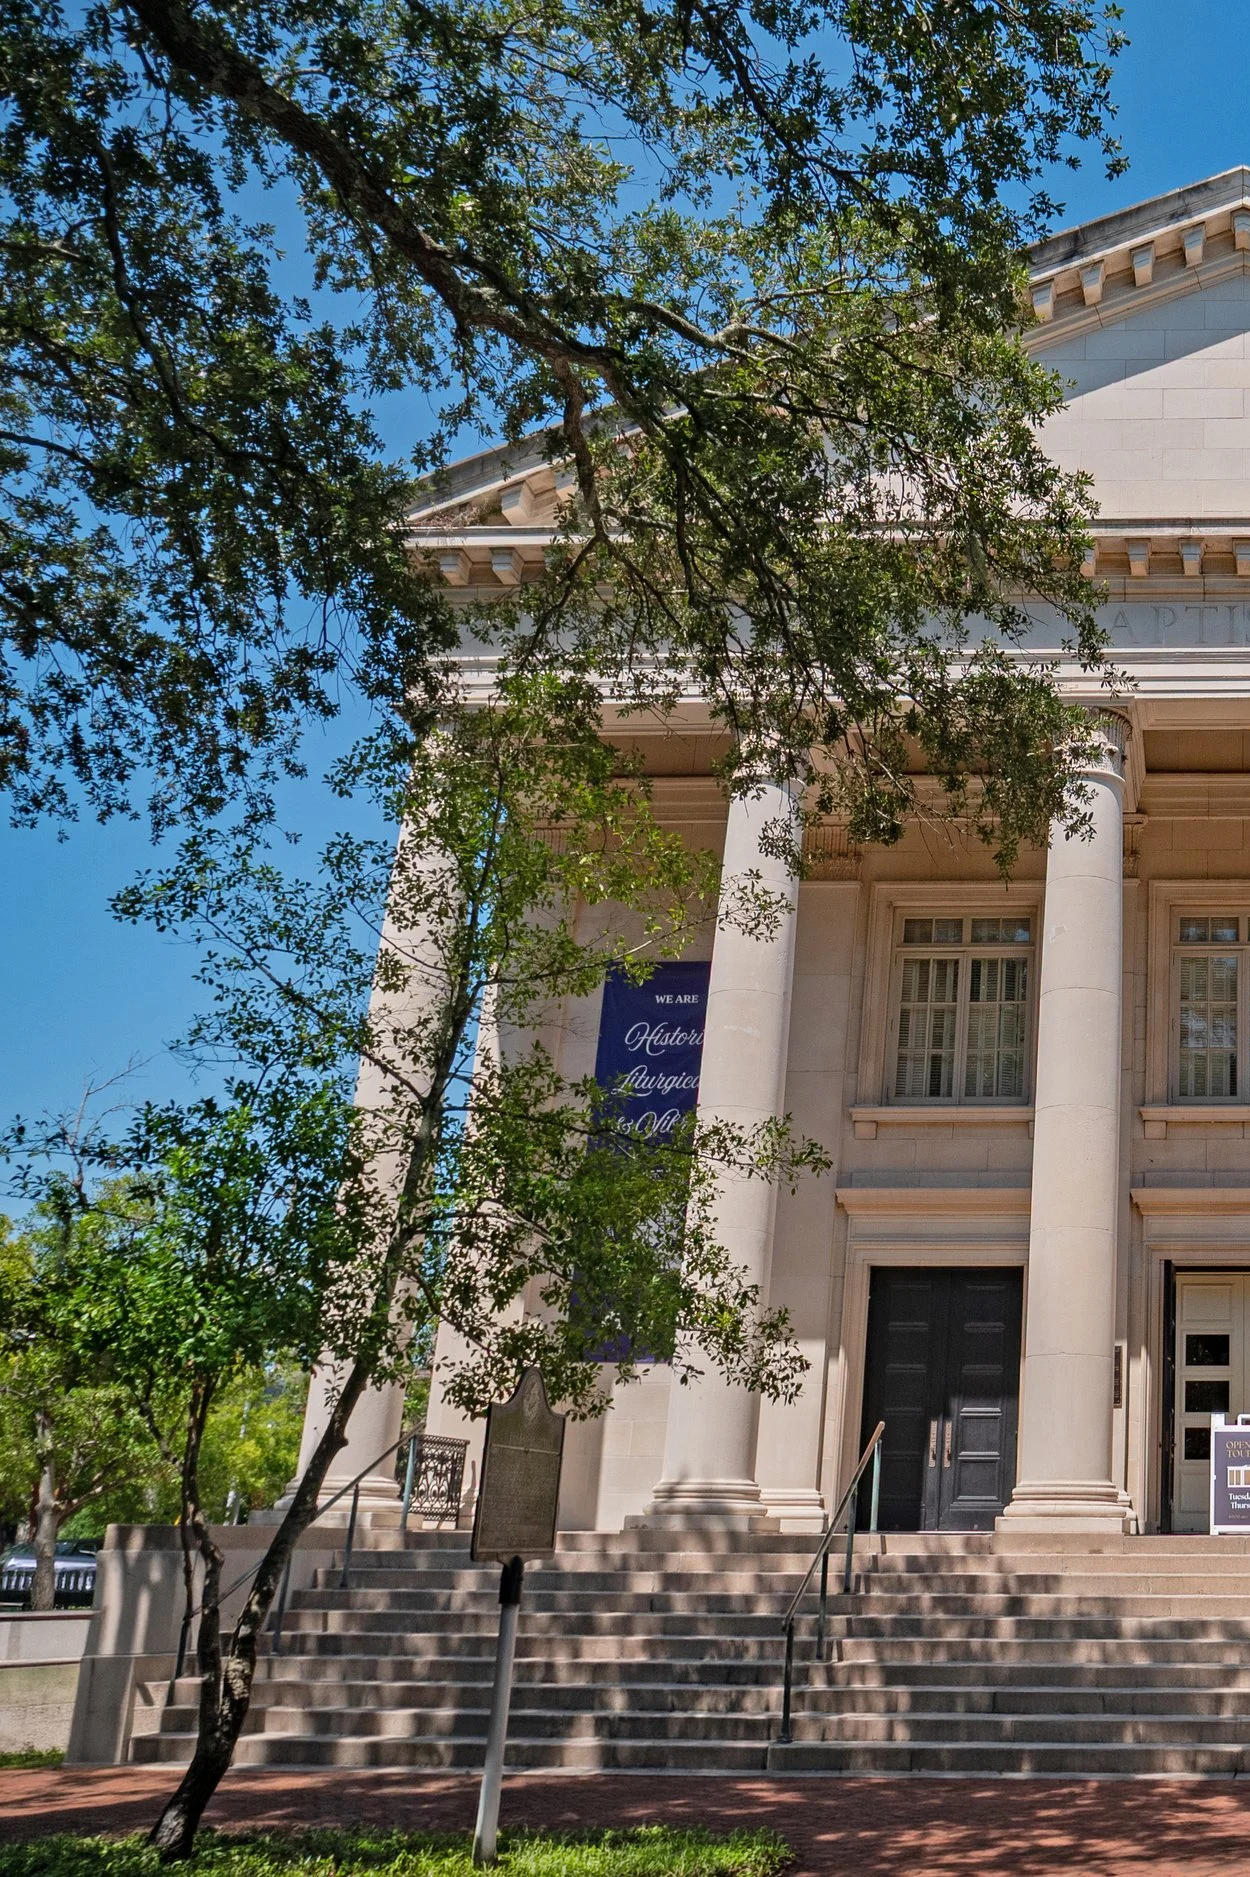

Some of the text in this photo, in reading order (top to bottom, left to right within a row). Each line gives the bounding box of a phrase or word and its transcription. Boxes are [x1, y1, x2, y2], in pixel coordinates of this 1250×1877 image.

[655, 994, 699, 1004] WE ARE
[624, 1021, 705, 1056] Histori
[1226, 1441, 1250, 1449] OPEN
